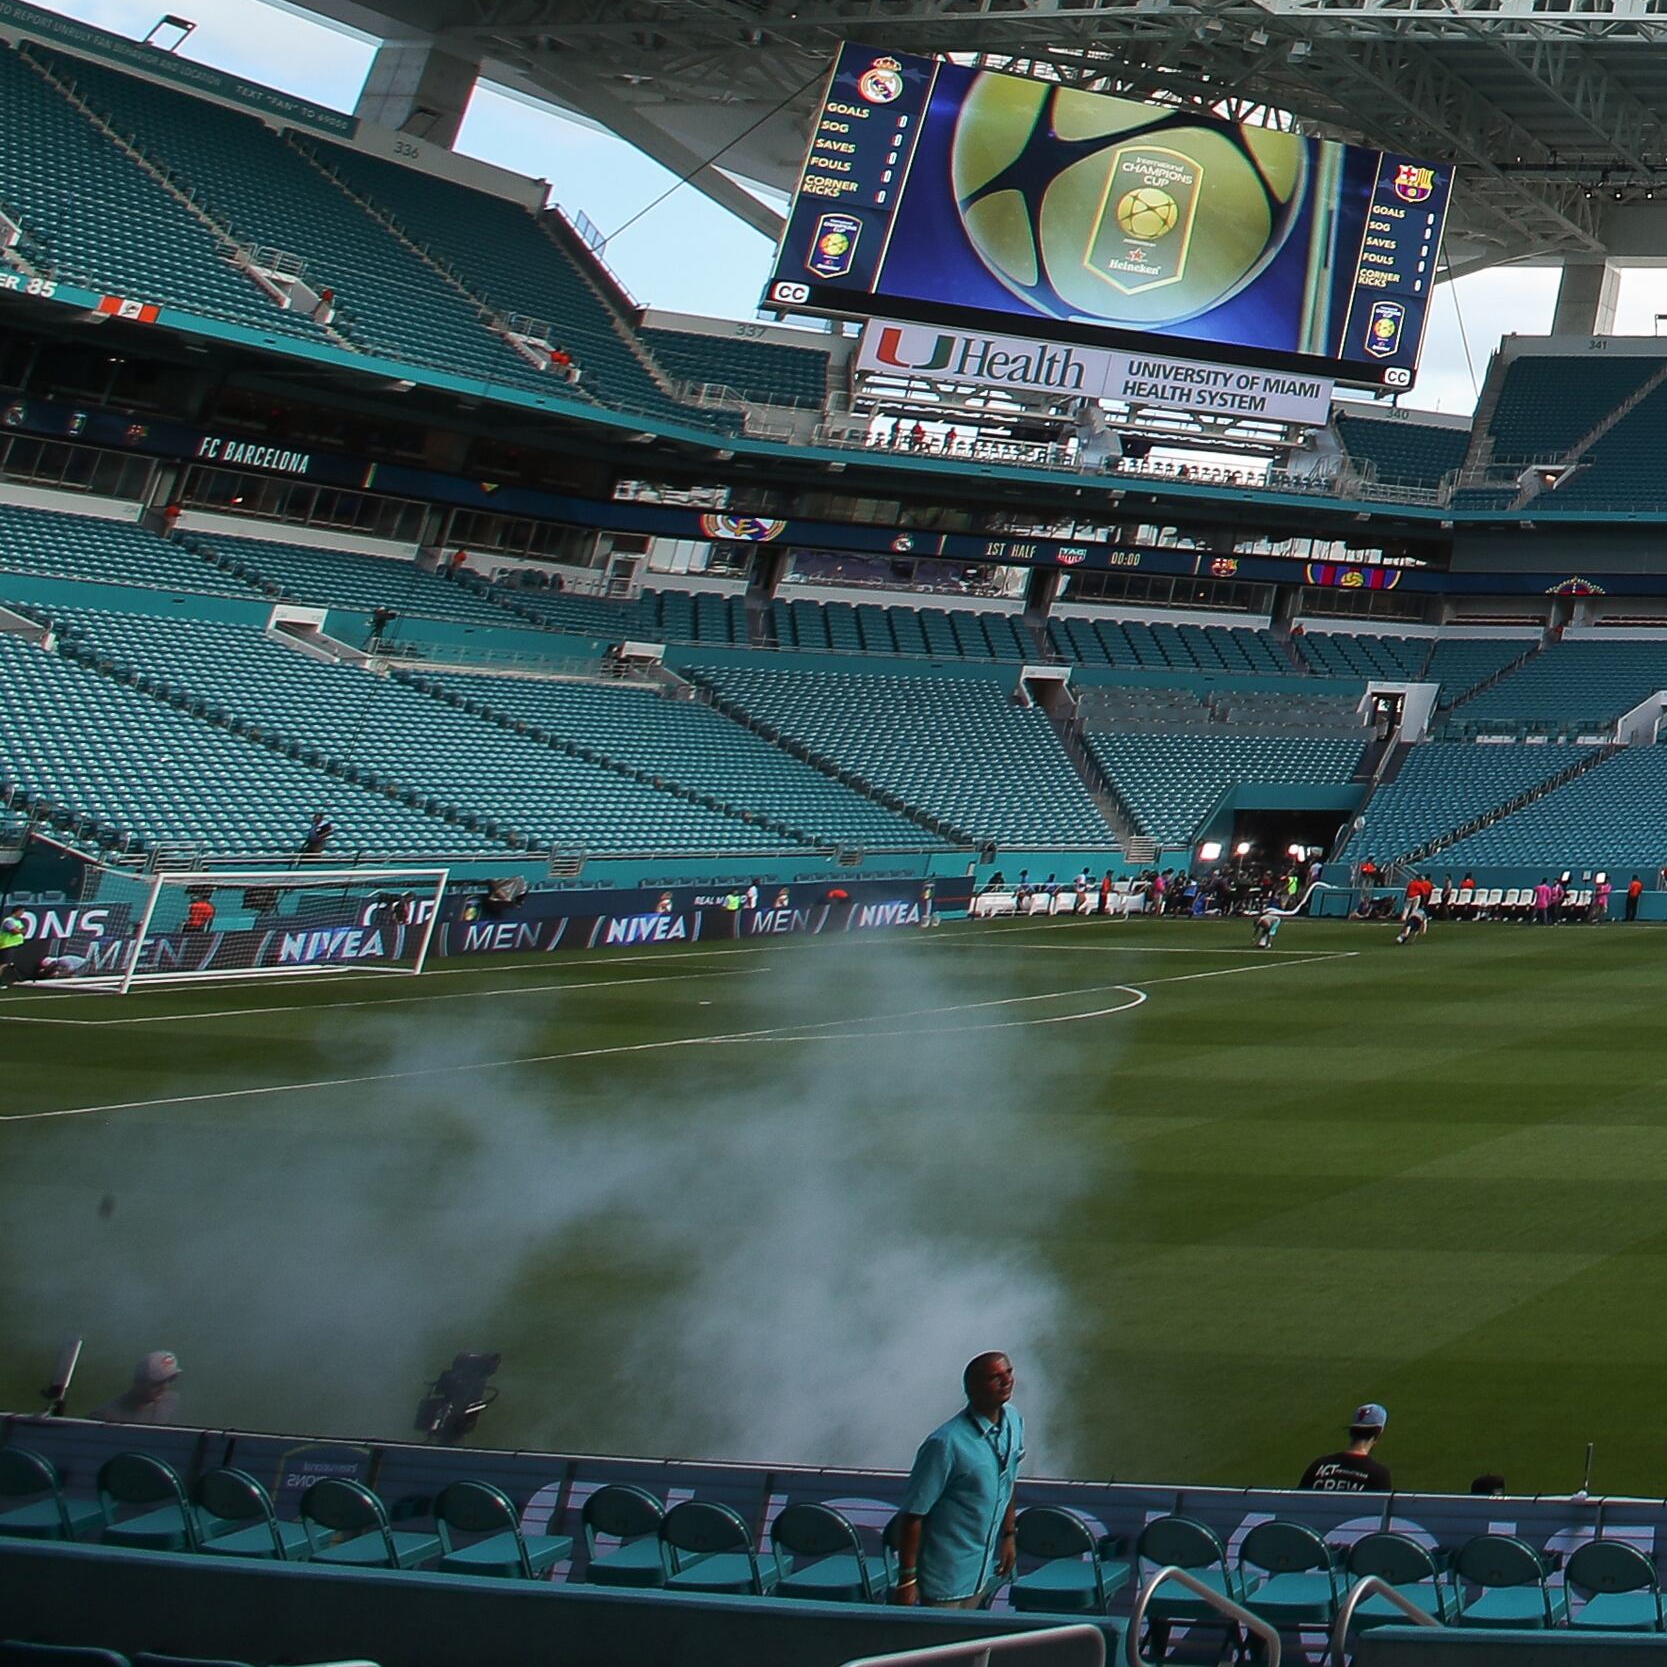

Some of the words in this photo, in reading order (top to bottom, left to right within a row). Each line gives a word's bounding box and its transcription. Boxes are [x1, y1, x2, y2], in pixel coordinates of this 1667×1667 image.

[236, 85, 263, 101] TEXT
[302, 106, 316, 118] TO
[827, 102, 870, 118] GOALS
[821, 120, 849, 133] SOG
[900, 115, 908, 129] 0
[815, 138, 856, 153] SAVES
[894, 134, 902, 147] 0
[394, 141, 420, 159] 336
[810, 157, 851, 171] FOULS
[888, 152, 897, 165] 0
[1136, 157, 1184, 172] International
[883, 170, 891, 183] 0
[1122, 162, 1192, 184] CHAMPIONS
[805, 175, 858, 192] CORNER
[1144, 175, 1169, 187] CUP
[803, 184, 841, 198] KICKS
[878, 191, 886, 203] 0
[1373, 205, 1405, 218] GOALS
[1369, 221, 1391, 232] SOG
[1366, 237, 1397, 249] SAVES
[1363, 253, 1394, 265] FOULS
[1109, 259, 1160, 275] Heineken
[1358, 276, 1387, 287] KICKS
[1360, 269, 1400, 282] CORNER
[27, 277, 58, 298] 85
[778, 286, 805, 300] CC
[1128, 360, 1234, 389] UNIVERSITY
[1236, 374, 1260, 392] OF
[1263, 377, 1321, 399] MIAMI
[1388, 371, 1407, 383] CC
[1123, 380, 1193, 403] HEALTH
[1196, 389, 1266, 412] SYSTEM
[198, 437, 221, 458] FC
[223, 441, 310, 474] BARCELONA
[986, 542, 1006, 557] 1ST
[1010, 544, 1037, 559] HALF
[1111, 552, 1141, 566] 00:00
[752, 908, 810, 934] MEN
[860, 902, 919, 927] NIVEA
[464, 921, 543, 952] MEN
[606, 915, 686, 944] NIVEA
[279, 929, 384, 961] NIVEA
[88, 938, 188, 970] MEN
